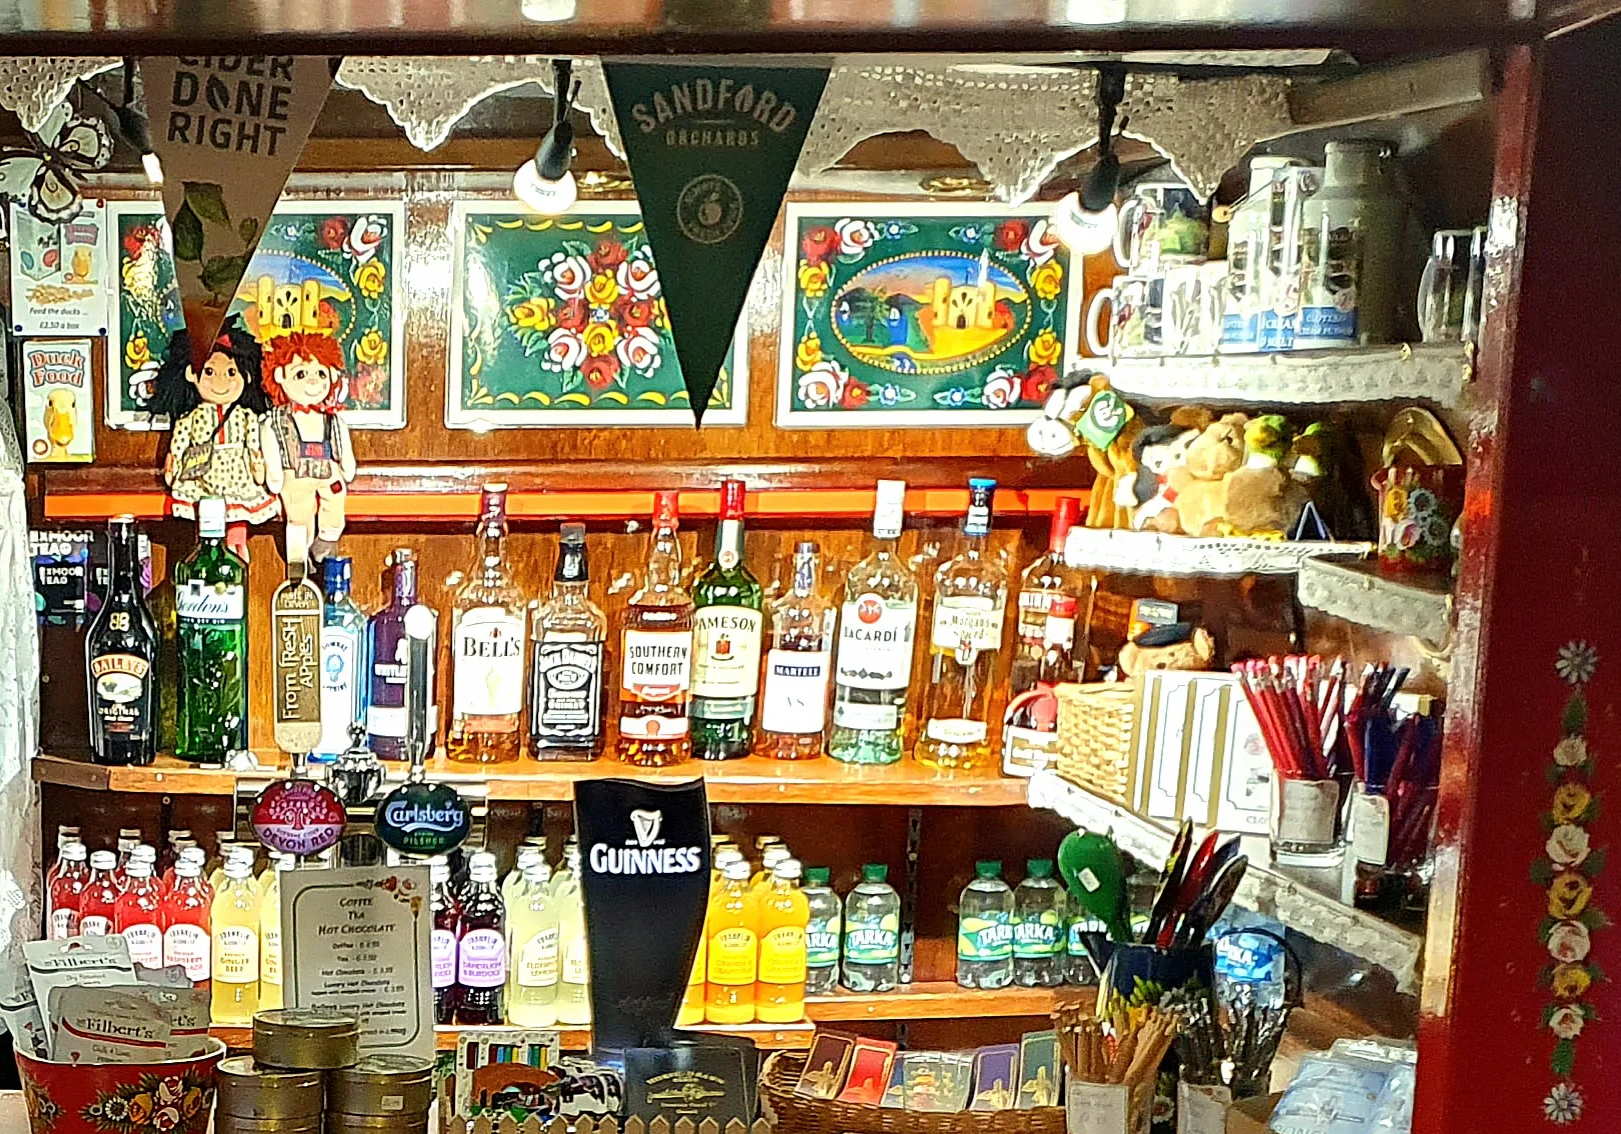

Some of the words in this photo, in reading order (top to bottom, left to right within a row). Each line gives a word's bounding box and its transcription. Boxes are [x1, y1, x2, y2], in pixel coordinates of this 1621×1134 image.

[171, 71, 292, 121] DONE
[632, 78, 797, 133] SANDFORD
[167, 111, 286, 156] RIGHT
[665, 129, 760, 147] ORCHARDS
[29, 350, 85, 371] Duck
[32, 368, 85, 388] Food
[463, 636, 521, 658] BELL'S
[629, 645, 688, 659] SOUTHERN
[93, 656, 146, 676] BAILEYS
[631, 662, 684, 676] COMFORT
[385, 799, 465, 828] Carlsberg
[262, 827, 306, 850] DEVON
[311, 827, 335, 848] RED
[589, 842, 702, 875] GUINNESS
[339, 897, 374, 908] COFFEE
[348, 910, 365, 921] TEA
[318, 924, 338, 936] HOT
[340, 923, 396, 935] CHOCOLATE
[849, 928, 894, 949] TARKA
[86, 1020, 155, 1039] Filbert's
